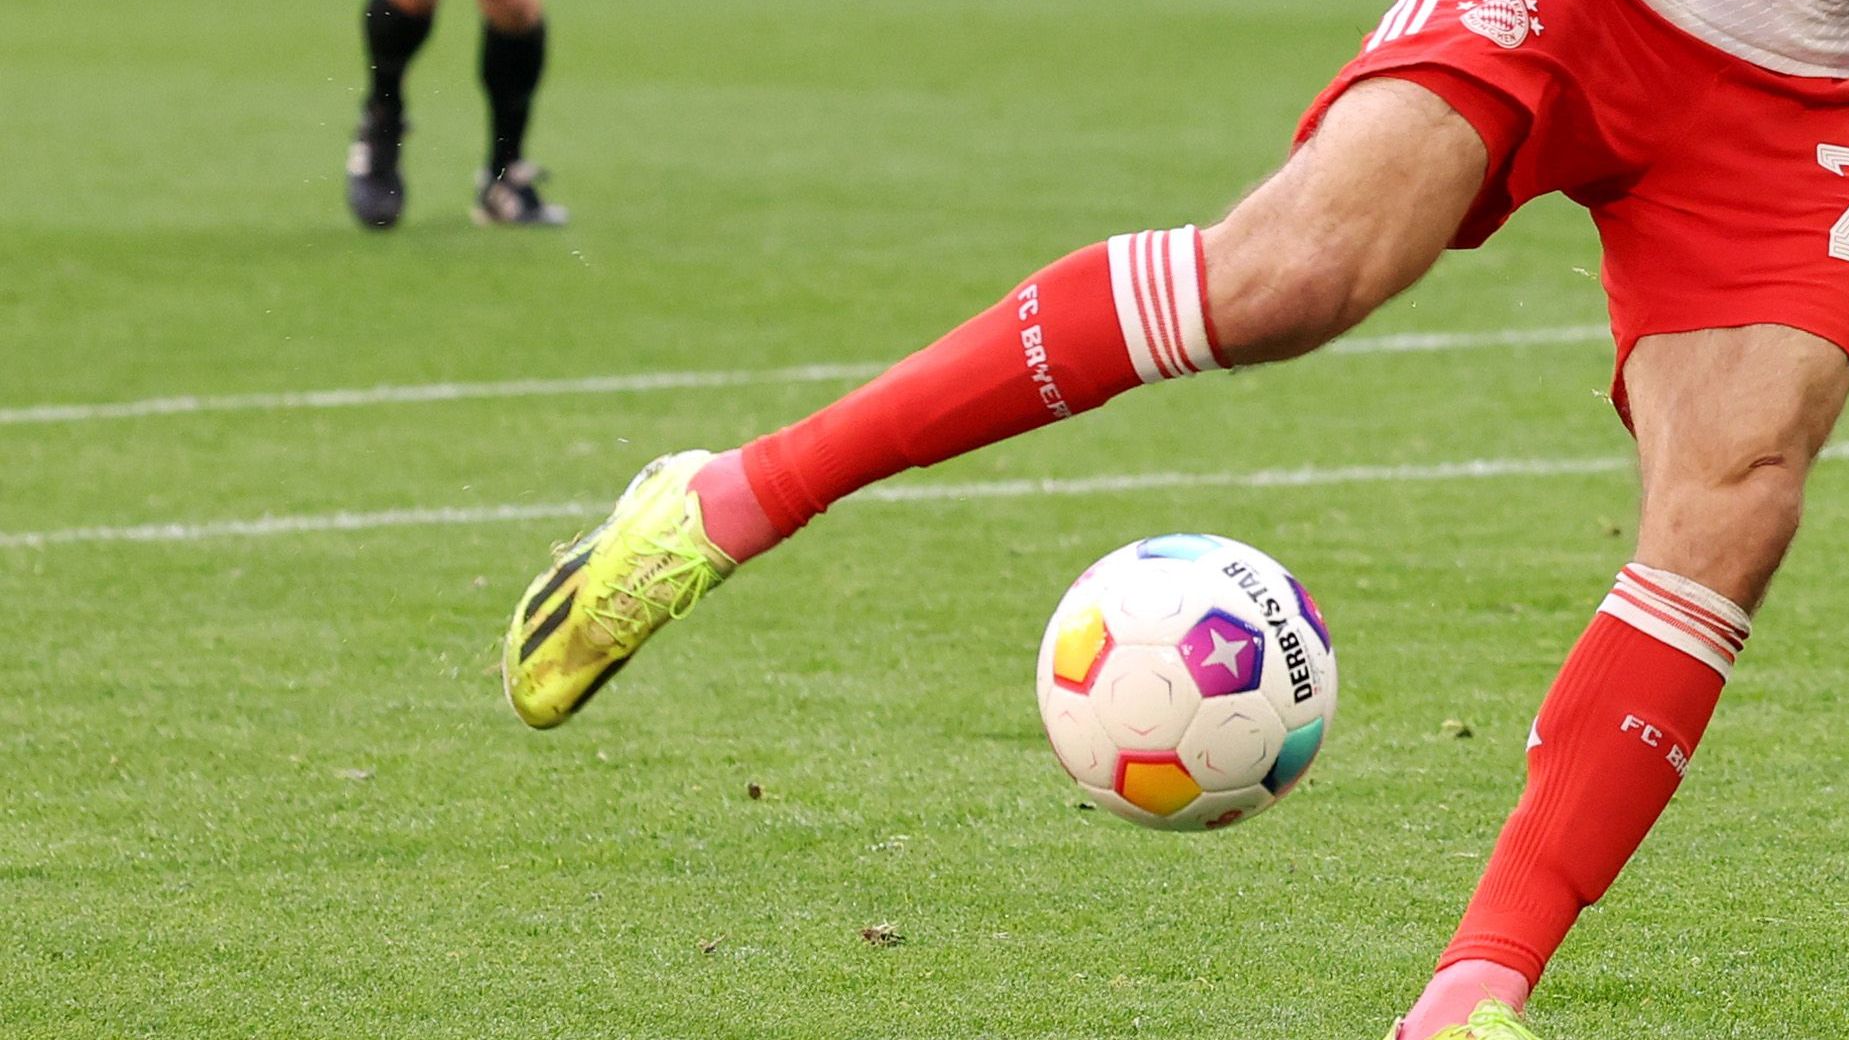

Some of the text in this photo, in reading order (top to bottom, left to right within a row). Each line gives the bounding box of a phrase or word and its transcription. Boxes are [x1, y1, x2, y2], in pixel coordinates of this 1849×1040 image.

[1018, 284, 1038, 320] FC
[1222, 561, 1313, 705] DERBYSTAR
[1620, 714, 1662, 748] FC
